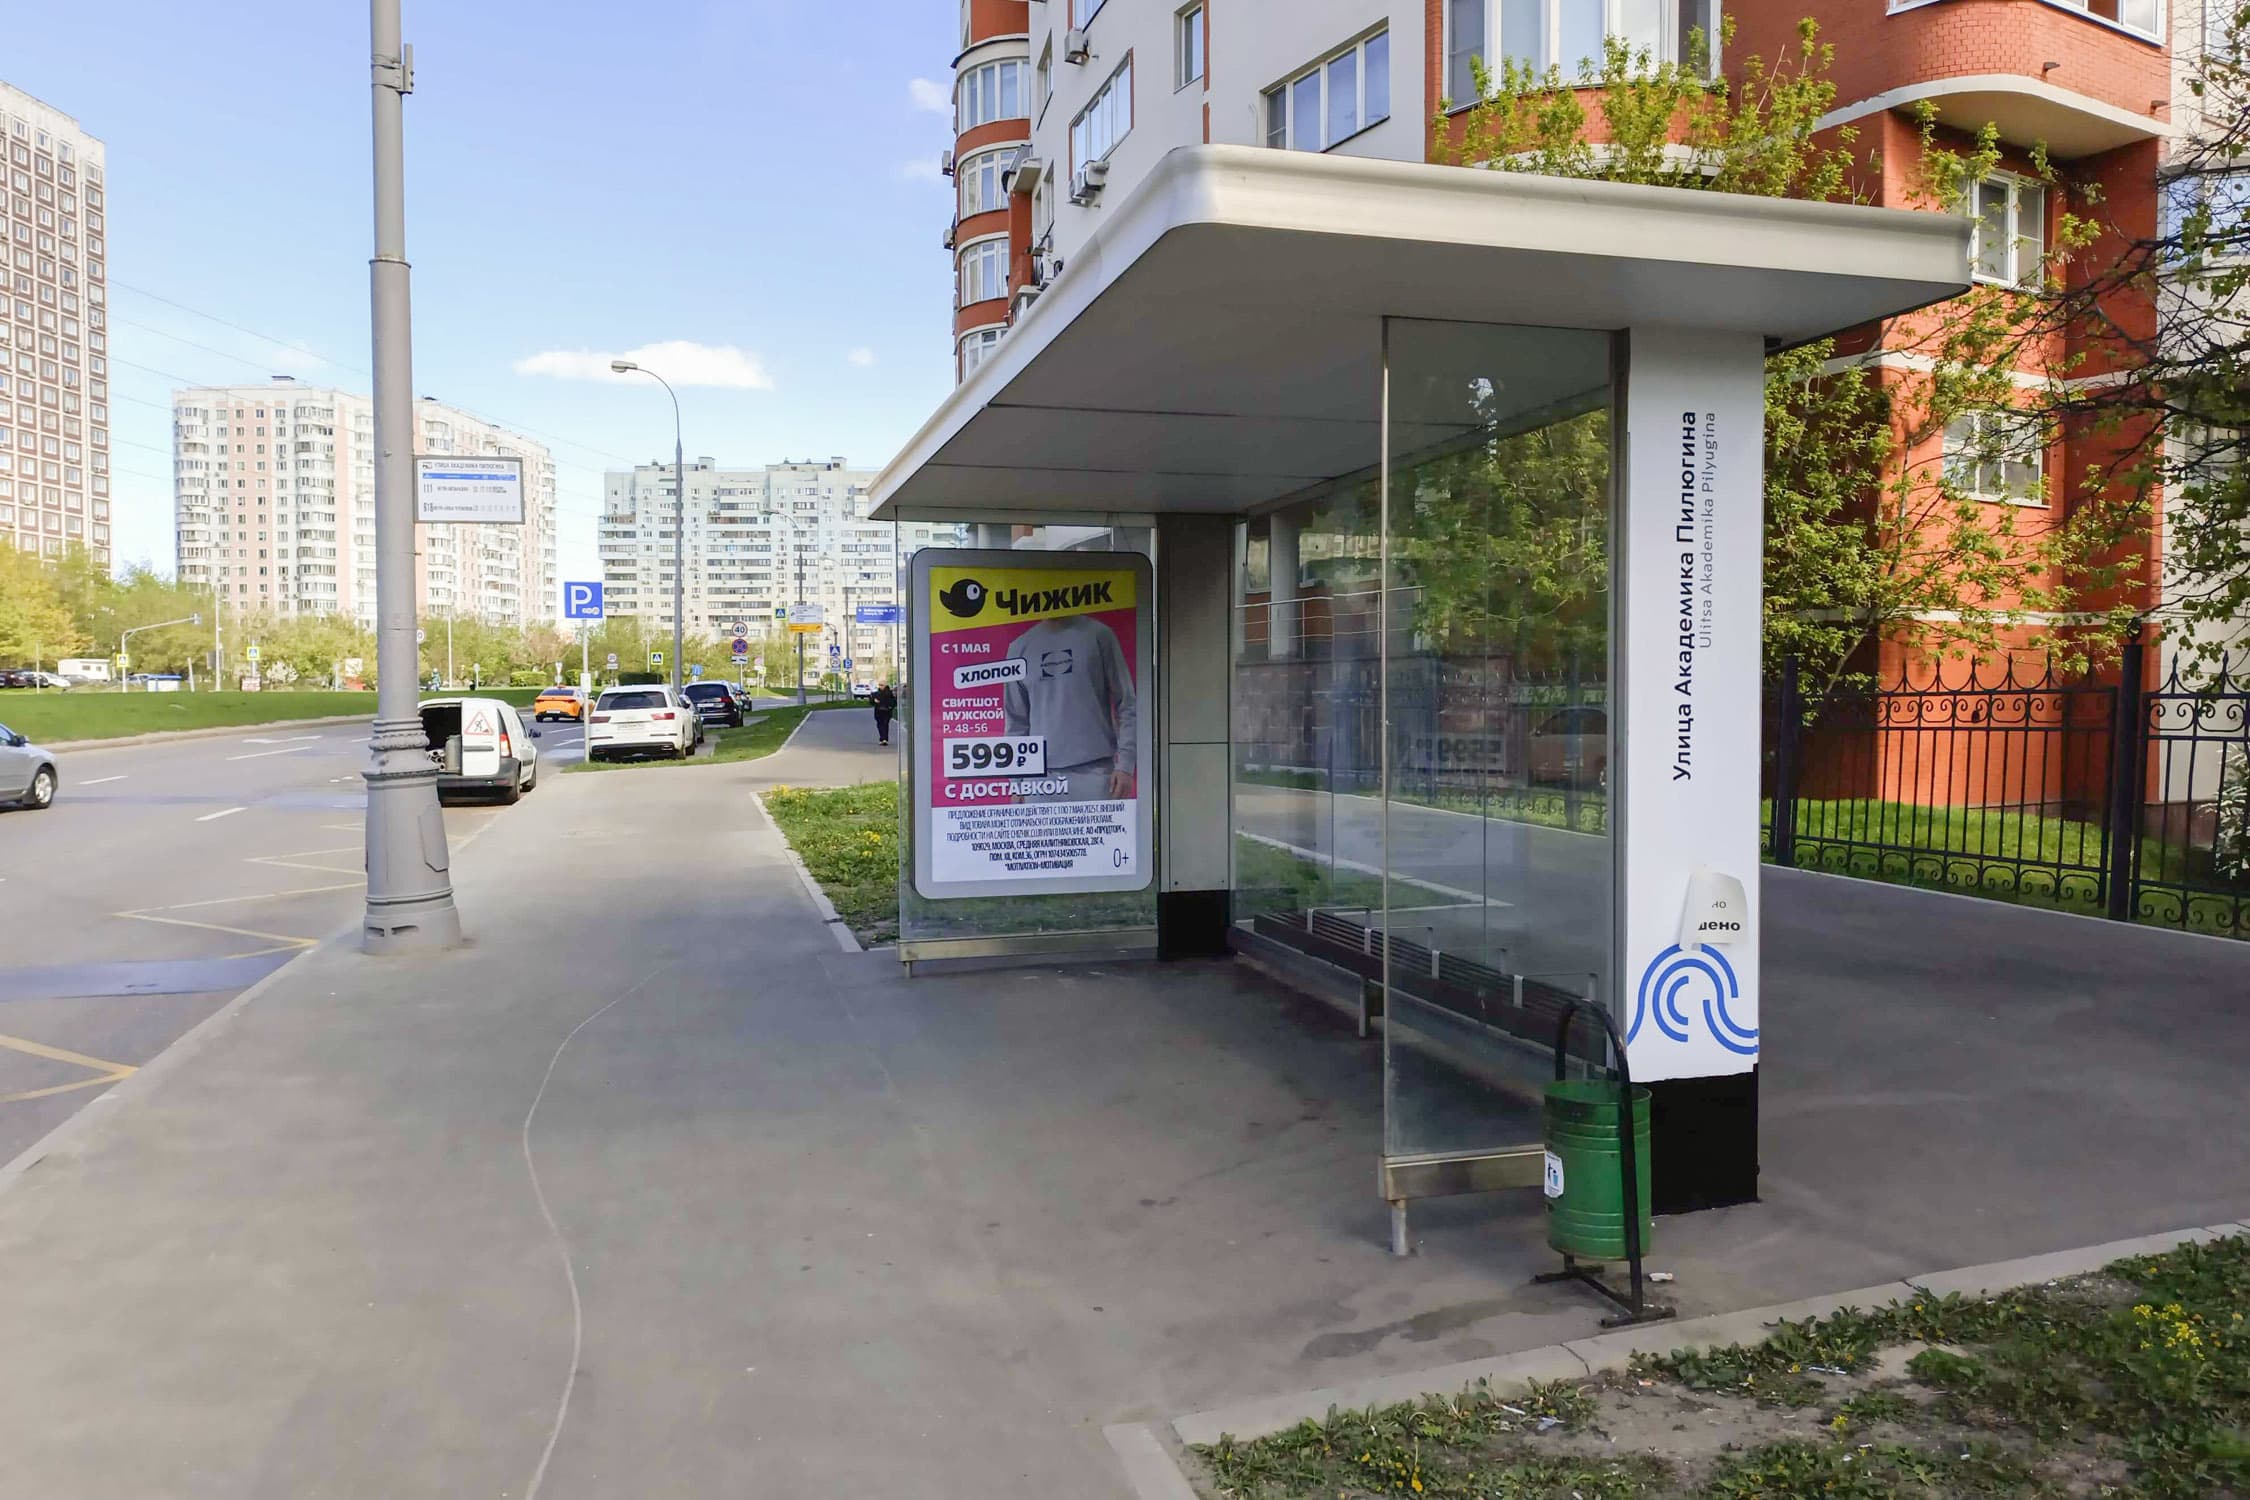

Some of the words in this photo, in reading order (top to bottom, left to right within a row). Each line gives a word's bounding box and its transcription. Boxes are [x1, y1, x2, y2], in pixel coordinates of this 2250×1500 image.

[1702, 412, 1718, 493] Pilyugina
[1676, 411, 1697, 544] Пилюгина
[1701, 498, 1714, 595] Akademika
[570, 585, 593, 615] P
[1674, 552, 1695, 697] Академика
[1700, 600, 1712, 648] Ulitsa
[941, 644, 950, 653] С
[952, 643, 958, 653] 1
[961, 643, 990, 653] МАЯ
[960, 664, 1021, 683] ХЛОПОК
[942, 697, 999, 708] СВИТШОТ
[942, 708, 1004, 721] МУЖСКОЙ
[943, 724, 952, 734] Р.
[955, 723, 988, 733] 48-56
[1673, 703, 1692, 781] Улица
[952, 742, 1014, 770] 599
[1018, 742, 1039, 754] 00
[944, 784, 956, 799] С
[959, 776, 1069, 801] ДОСТАВКОЙ
[1113, 848, 1129, 868] 0+
